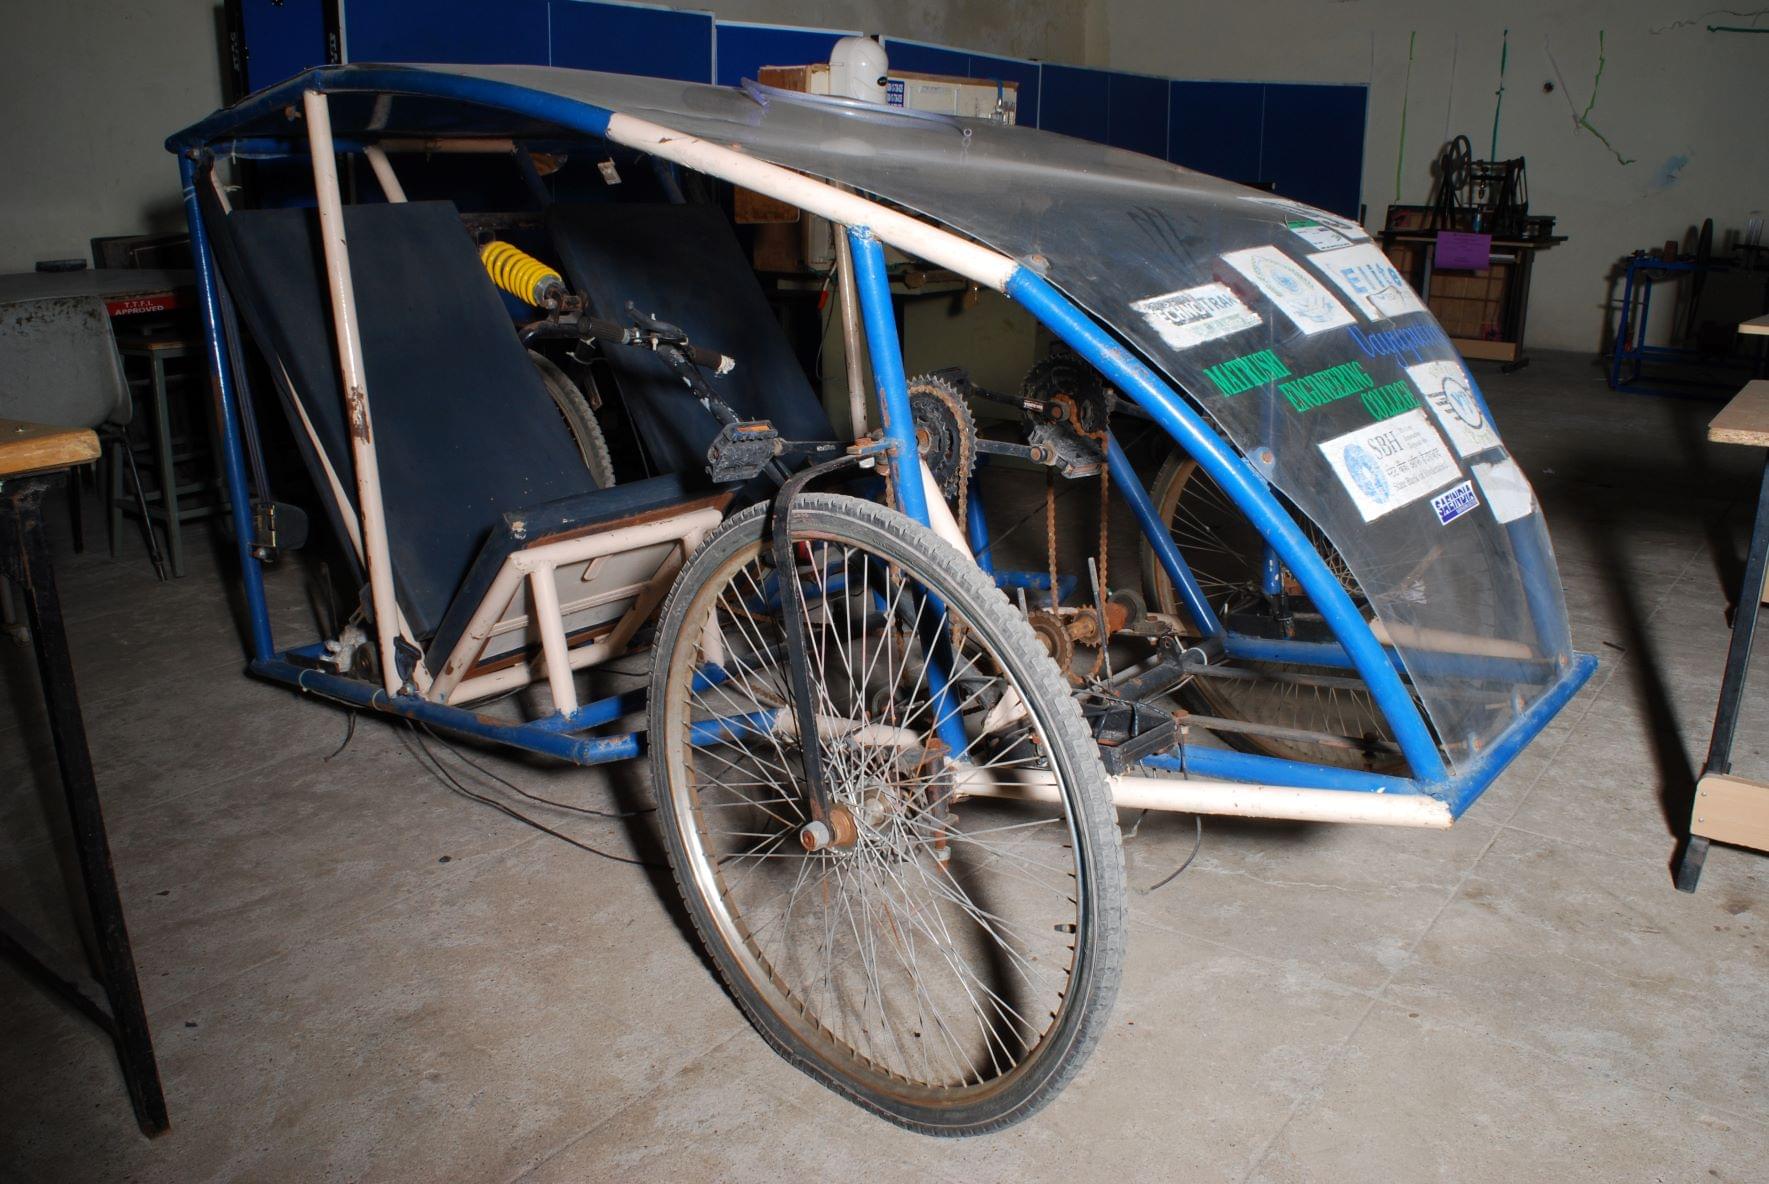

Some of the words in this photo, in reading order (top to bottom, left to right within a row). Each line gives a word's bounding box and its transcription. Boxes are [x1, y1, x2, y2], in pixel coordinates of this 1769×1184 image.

[115, 305, 164, 315] APPROVED
[124, 300, 154, 309] T.T.F.I.
[1279, 361, 1374, 412] ENGINEERING
[1361, 380, 1421, 421] COLLEGE
[1368, 431, 1403, 460] SBH
[1435, 485, 1474, 517] SAEINDIA
